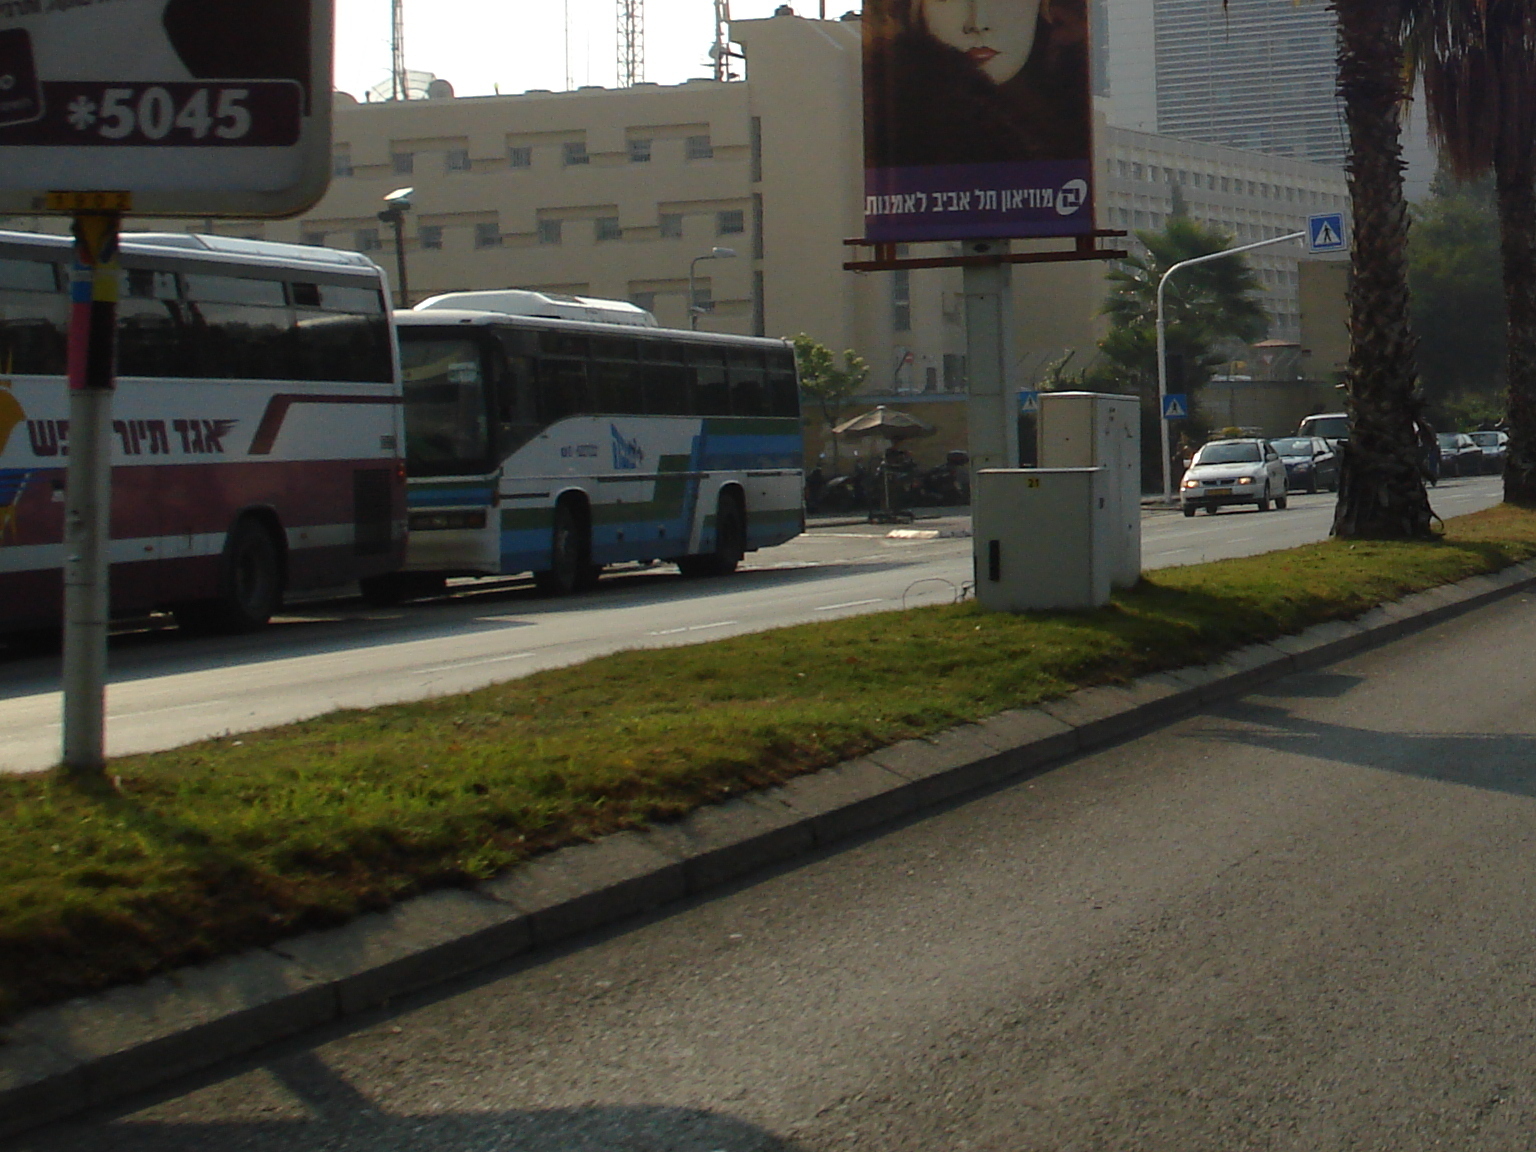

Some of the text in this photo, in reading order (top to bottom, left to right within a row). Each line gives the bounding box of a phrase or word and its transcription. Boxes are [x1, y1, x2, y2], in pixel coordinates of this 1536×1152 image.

[864, 188, 1054, 215] מוזיאון תל אביב לאמנות
[113, 419, 240, 455] אגד תיור
